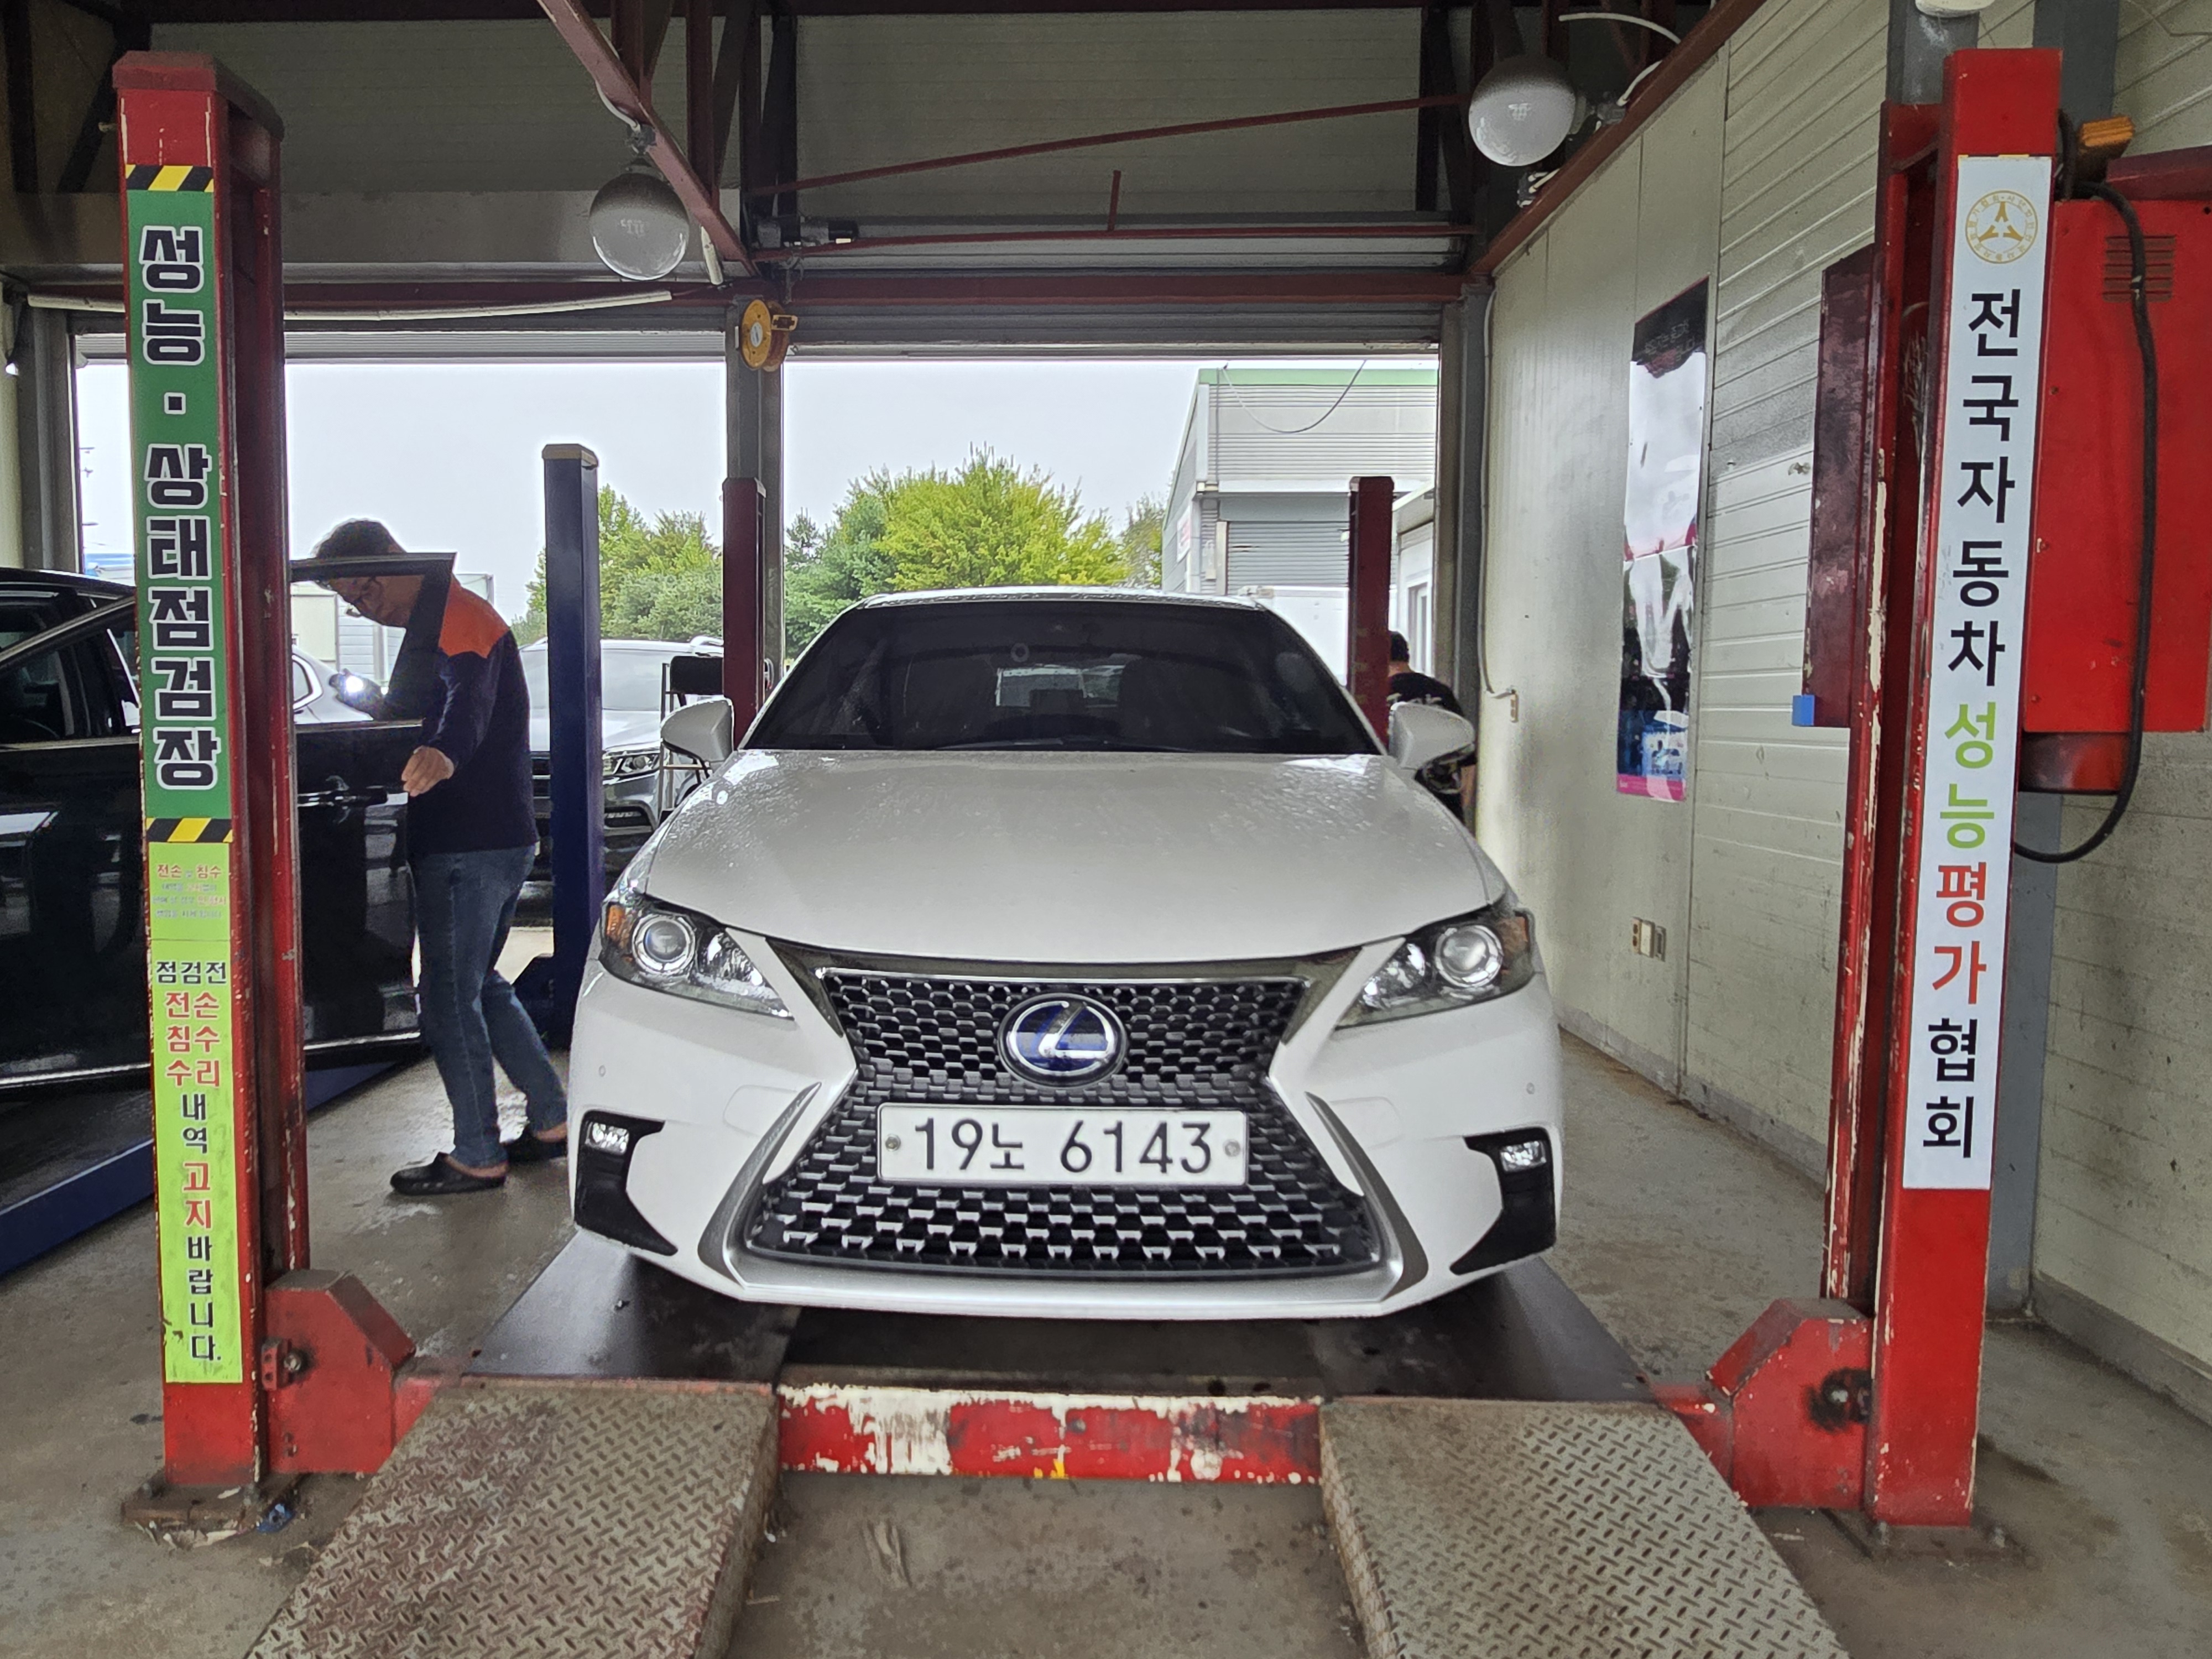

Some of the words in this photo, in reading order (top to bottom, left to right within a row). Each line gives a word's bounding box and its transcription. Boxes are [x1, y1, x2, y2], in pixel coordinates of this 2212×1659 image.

[158, 864, 181, 878] 전손
[196, 864, 221, 879] 침수
[156, 962, 227, 984] 점검전
[165, 992, 220, 1019] 전손
[166, 1026, 220, 1052] 침수
[166, 1060, 220, 1087] 수리
[915, 1117, 1024, 1171] 19노
[1060, 1120, 1212, 1173] 6143
